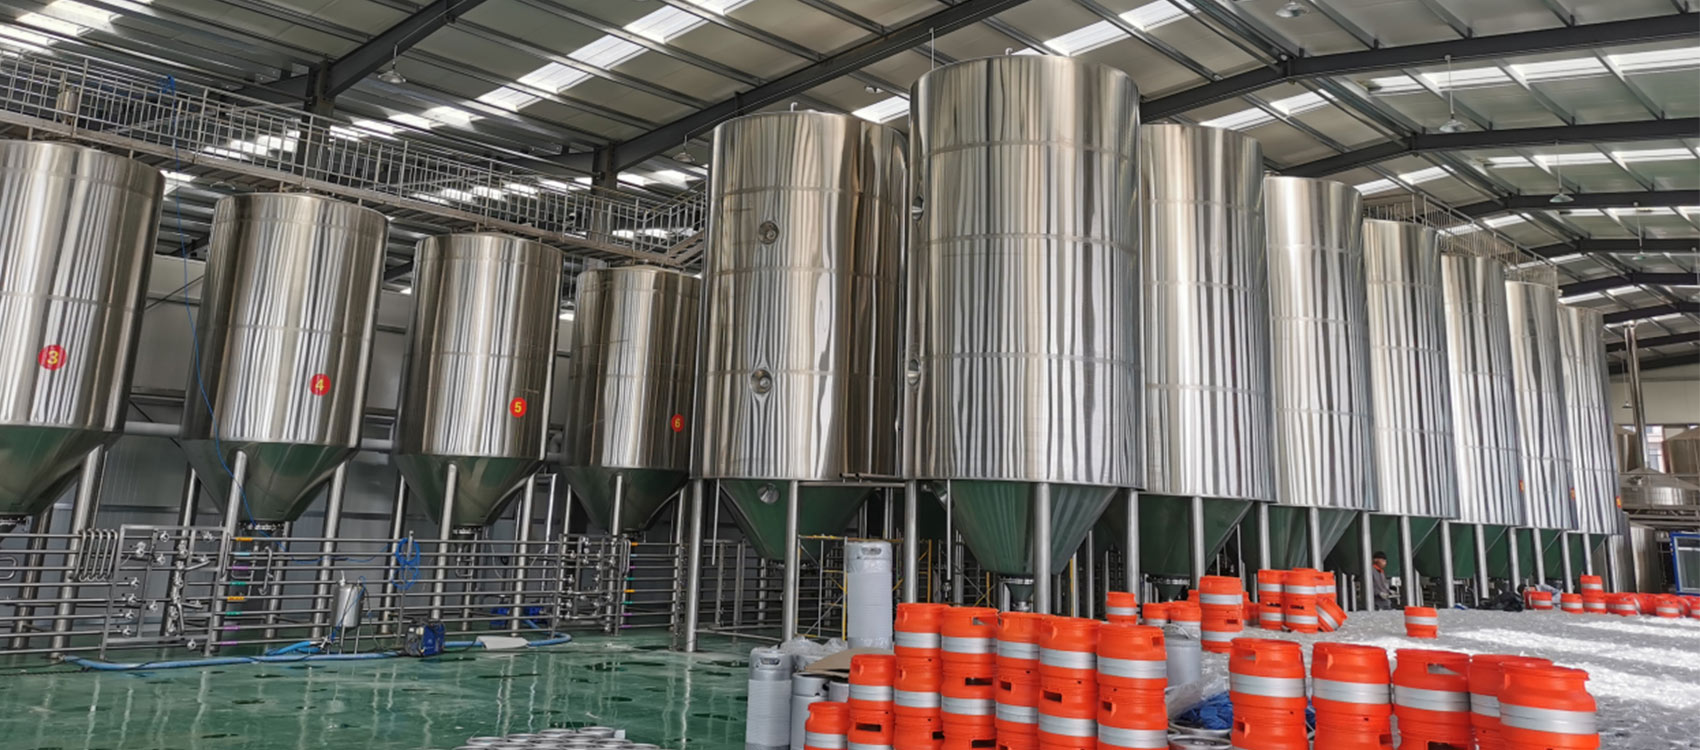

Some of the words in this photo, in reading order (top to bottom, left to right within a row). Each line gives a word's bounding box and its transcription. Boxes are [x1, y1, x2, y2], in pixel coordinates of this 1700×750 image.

[47, 350, 59, 365] 3
[315, 379, 324, 391] 4
[514, 401, 522, 413] 5
[674, 418, 681, 428] 6
